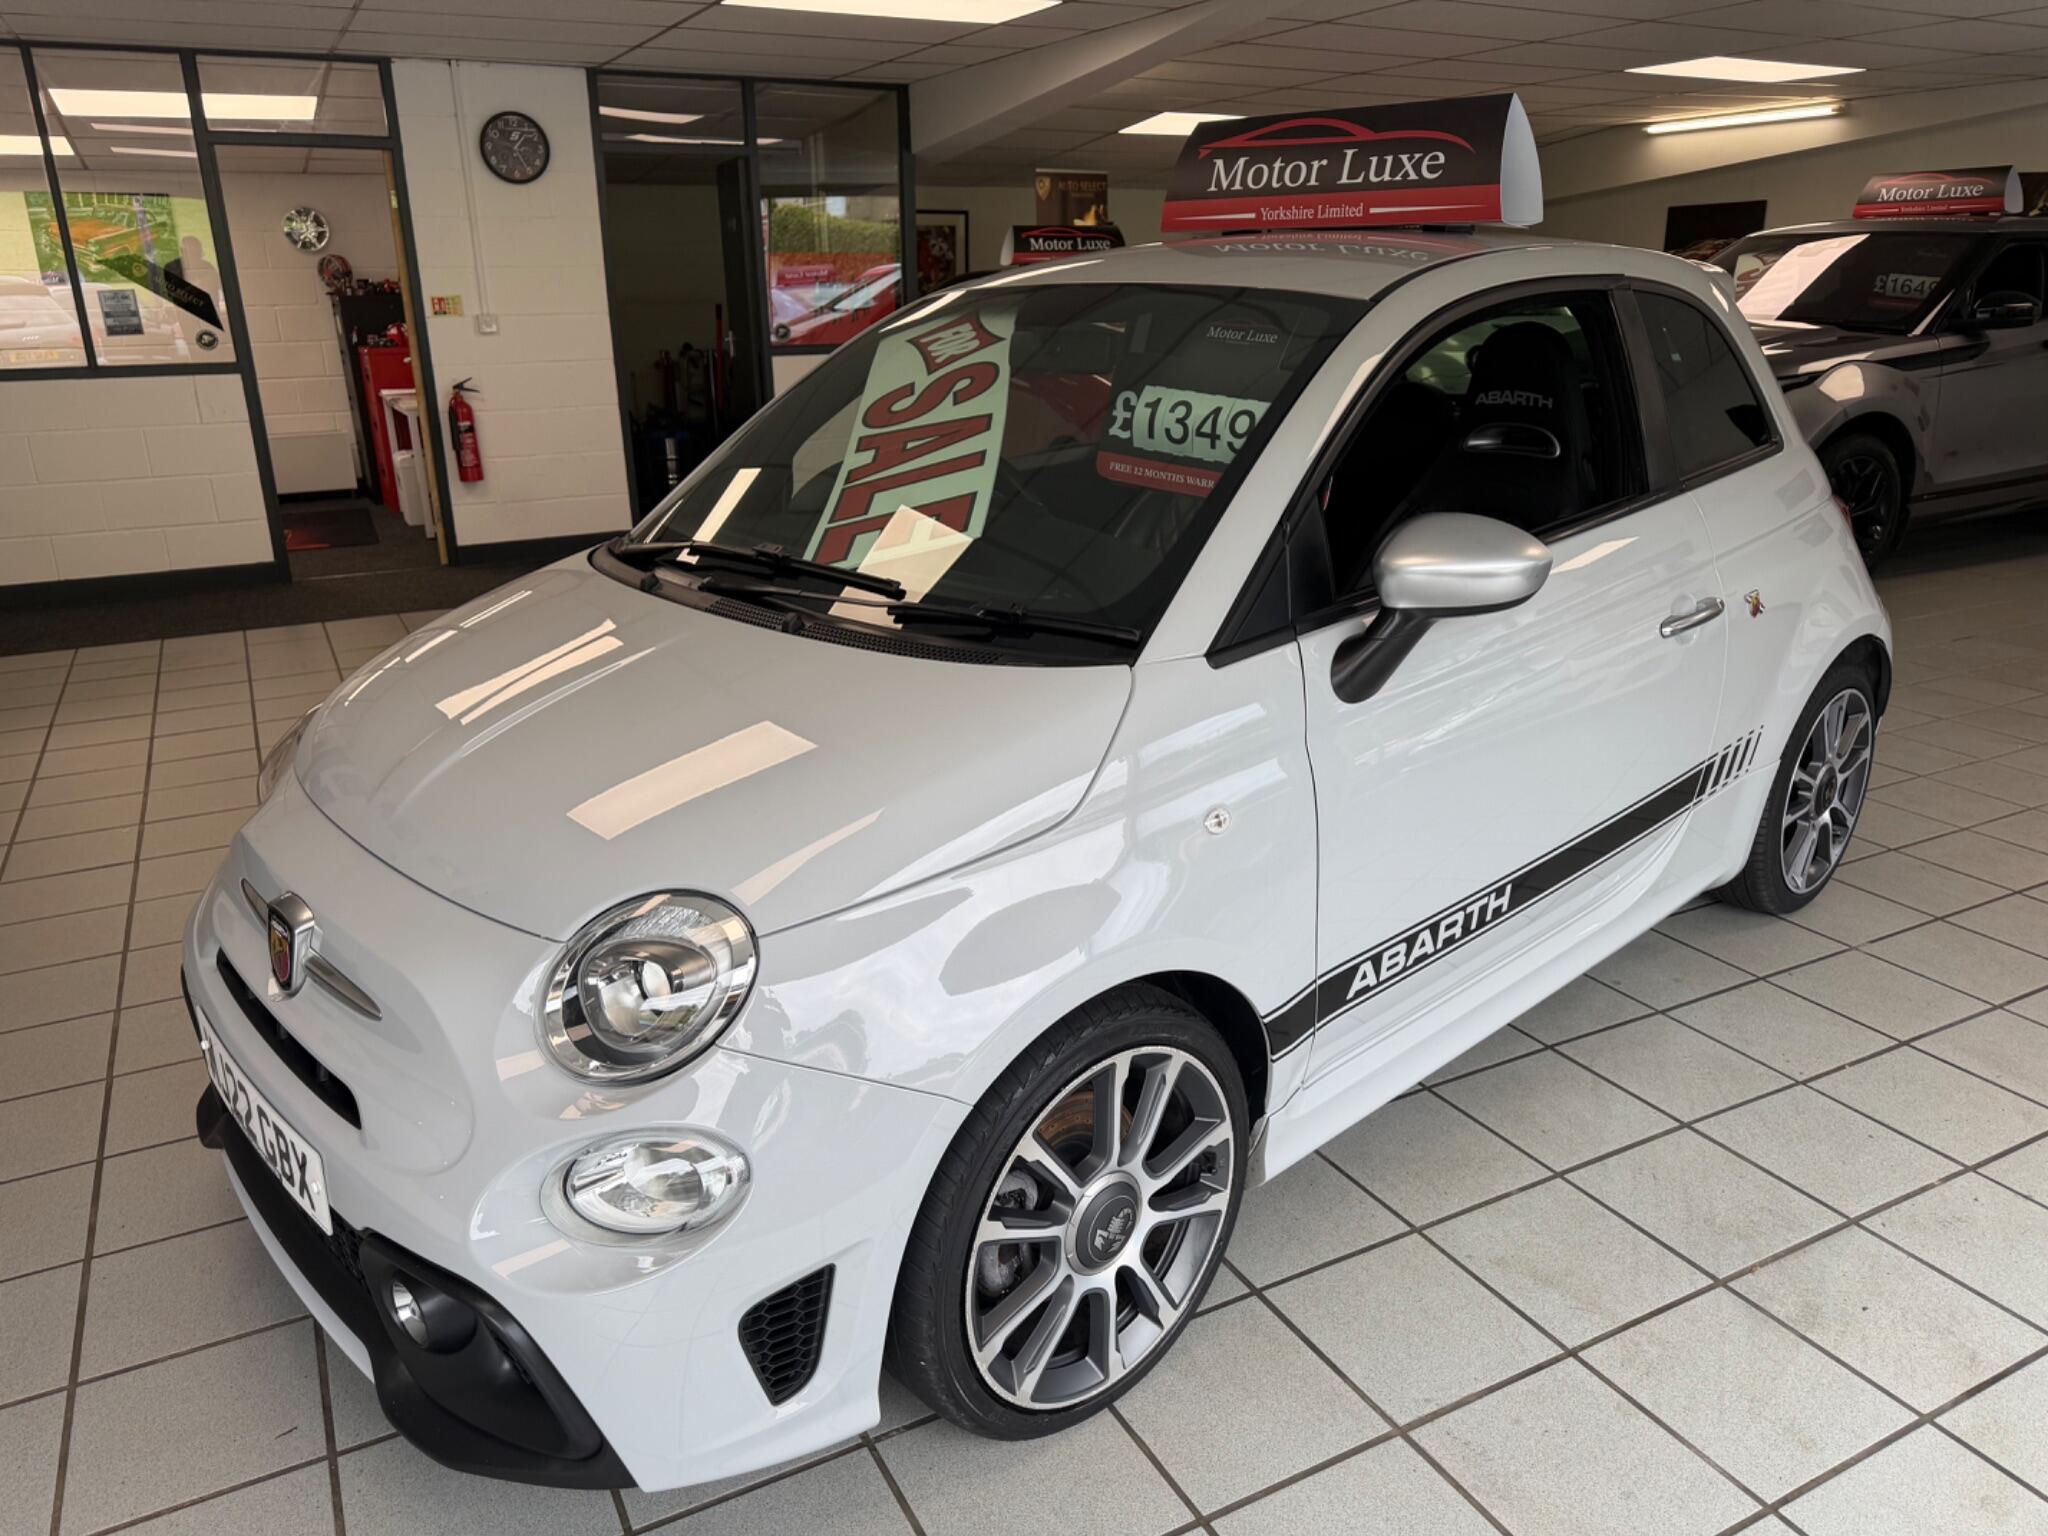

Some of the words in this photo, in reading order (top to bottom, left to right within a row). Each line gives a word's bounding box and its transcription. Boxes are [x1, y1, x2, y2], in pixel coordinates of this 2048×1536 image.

[487, 127, 500, 139] 10
[1207, 155, 1328, 192] Motor
[1336, 148, 1446, 186] Luxe
[1876, 187, 1933, 202] Motor
[1937, 183, 1984, 199] Luxe
[1260, 206, 1315, 222] Yorkshire
[1317, 202, 1364, 219] Limited
[1029, 237, 1073, 251] Motor
[1076, 236, 1111, 251] Luxe
[919, 322, 980, 363] FOR
[1206, 326, 1244, 341] Motor
[1247, 328, 1279, 344] Luxe
[1475, 390, 1553, 409] ABARTH
[812, 361, 1000, 566] SALE
[1109, 461, 1132, 475] FREE
[1133, 467, 1143, 477] 12
[1143, 468, 1185, 484] MONTHS
[1346, 883, 1512, 1000] ABARTH
